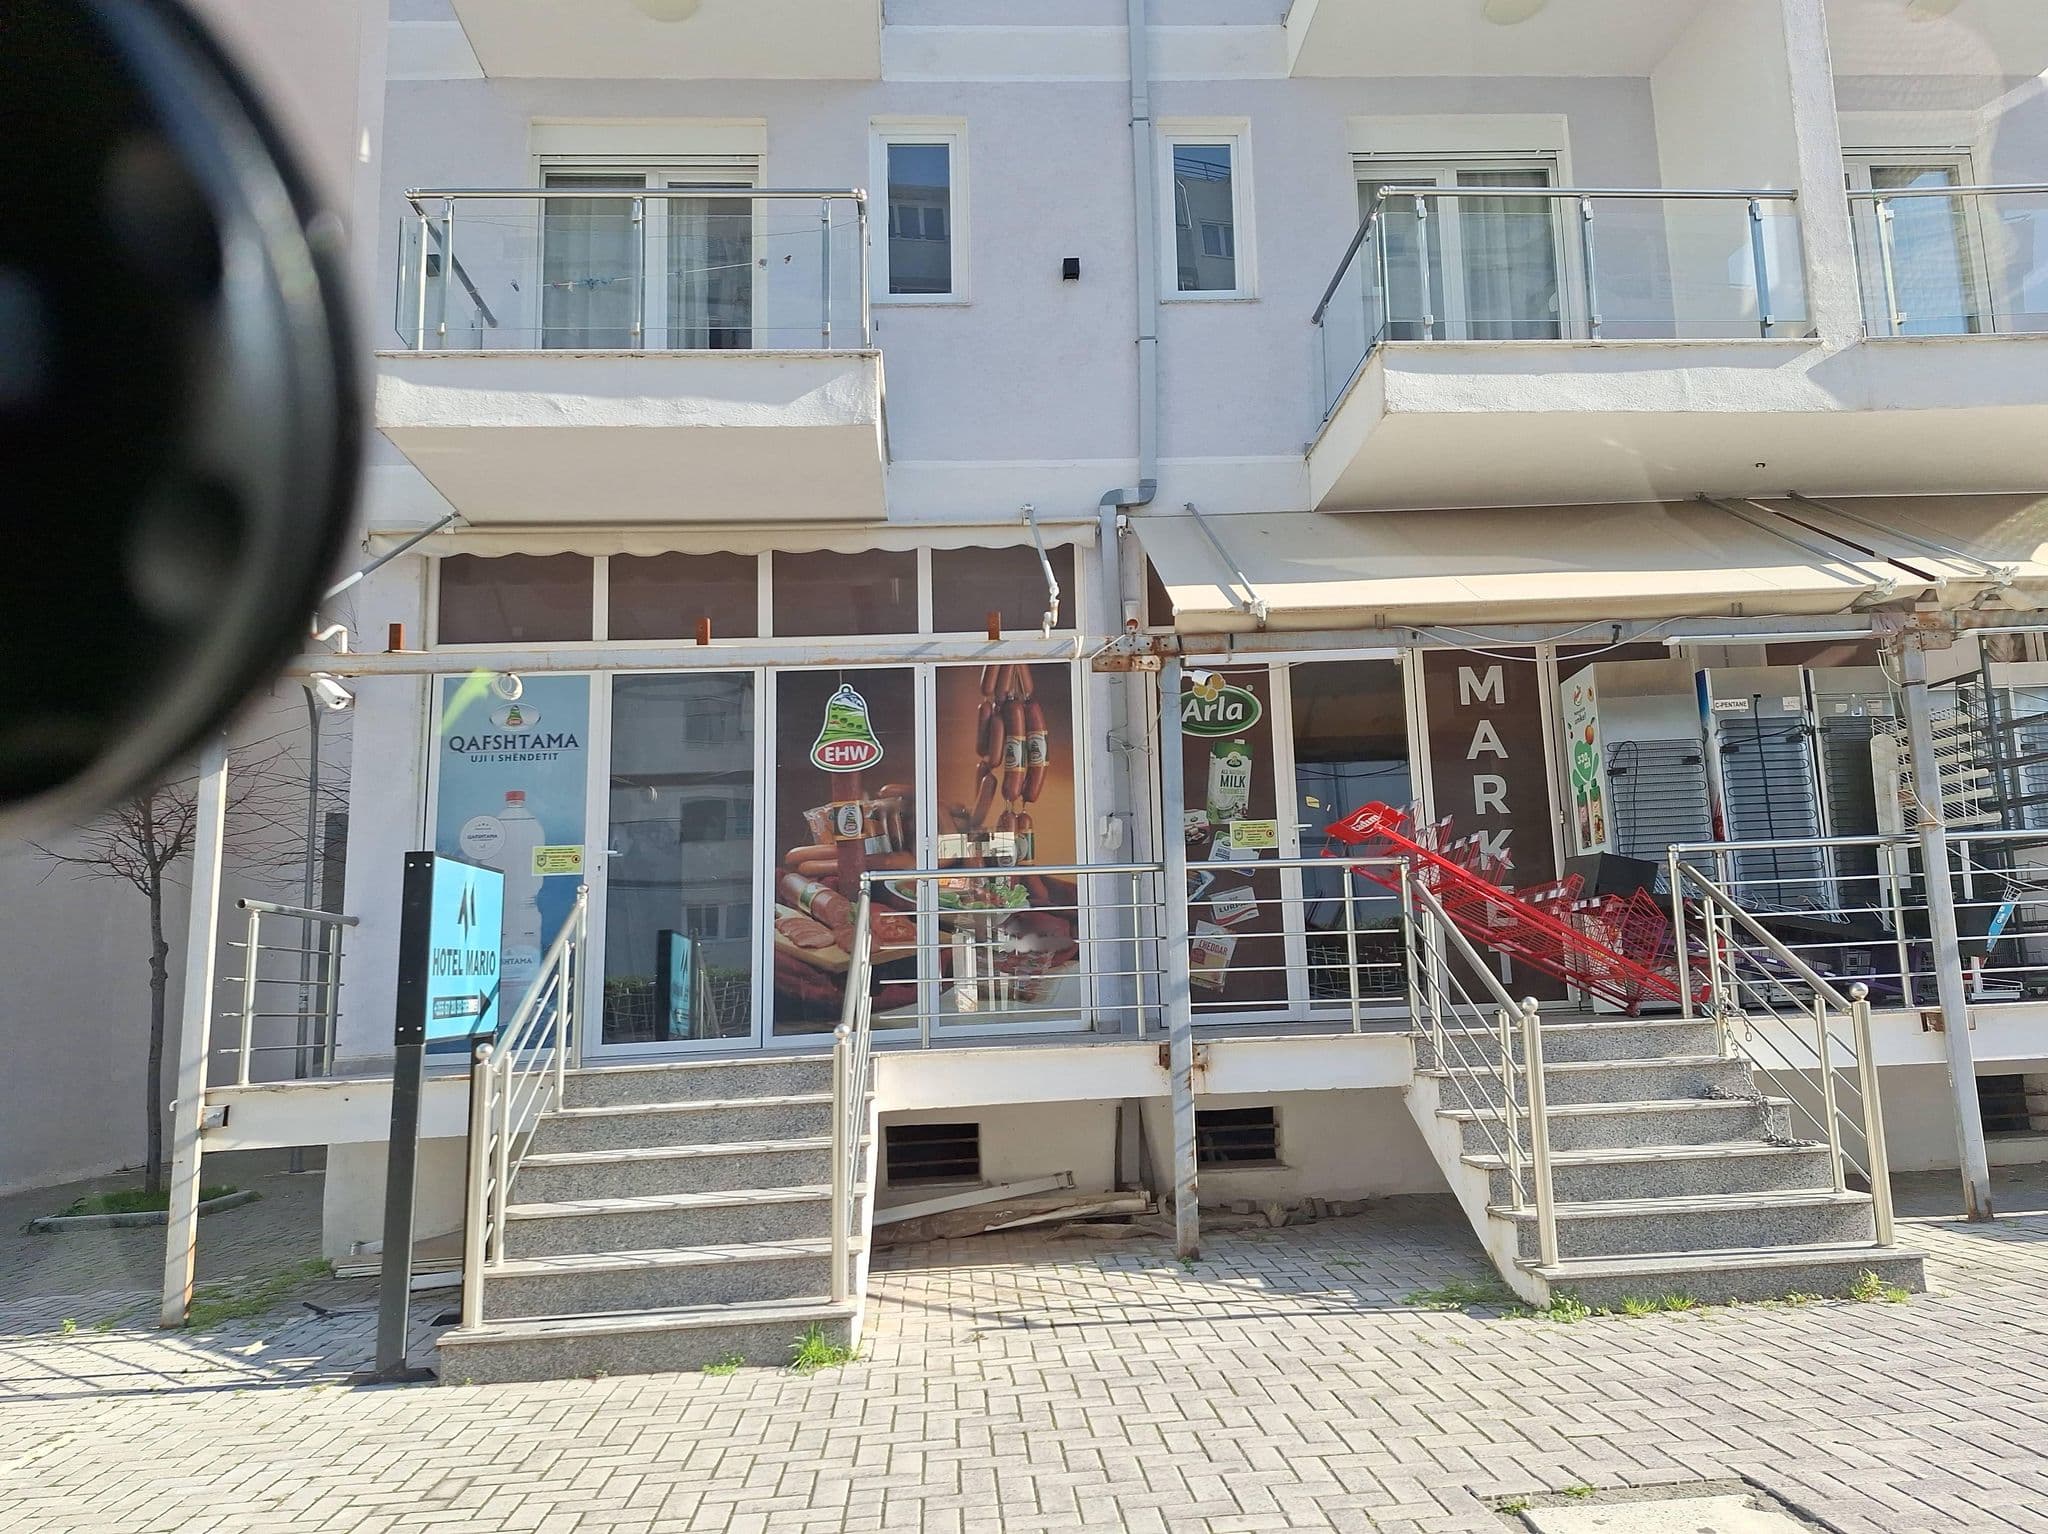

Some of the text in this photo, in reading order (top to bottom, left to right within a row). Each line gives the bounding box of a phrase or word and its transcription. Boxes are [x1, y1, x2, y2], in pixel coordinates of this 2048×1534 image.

[1181, 696, 1243, 722] Arla
[1715, 701, 1748, 709] C-PENTANE
[449, 733, 579, 753] QAFSHTAMA
[470, 755, 487, 763] UJI
[824, 745, 869, 762] EHW
[1220, 774, 1246, 788] MILK
[1219, 901, 1250, 913] LURP
[432, 948, 496, 977] HOTEL MARIO
